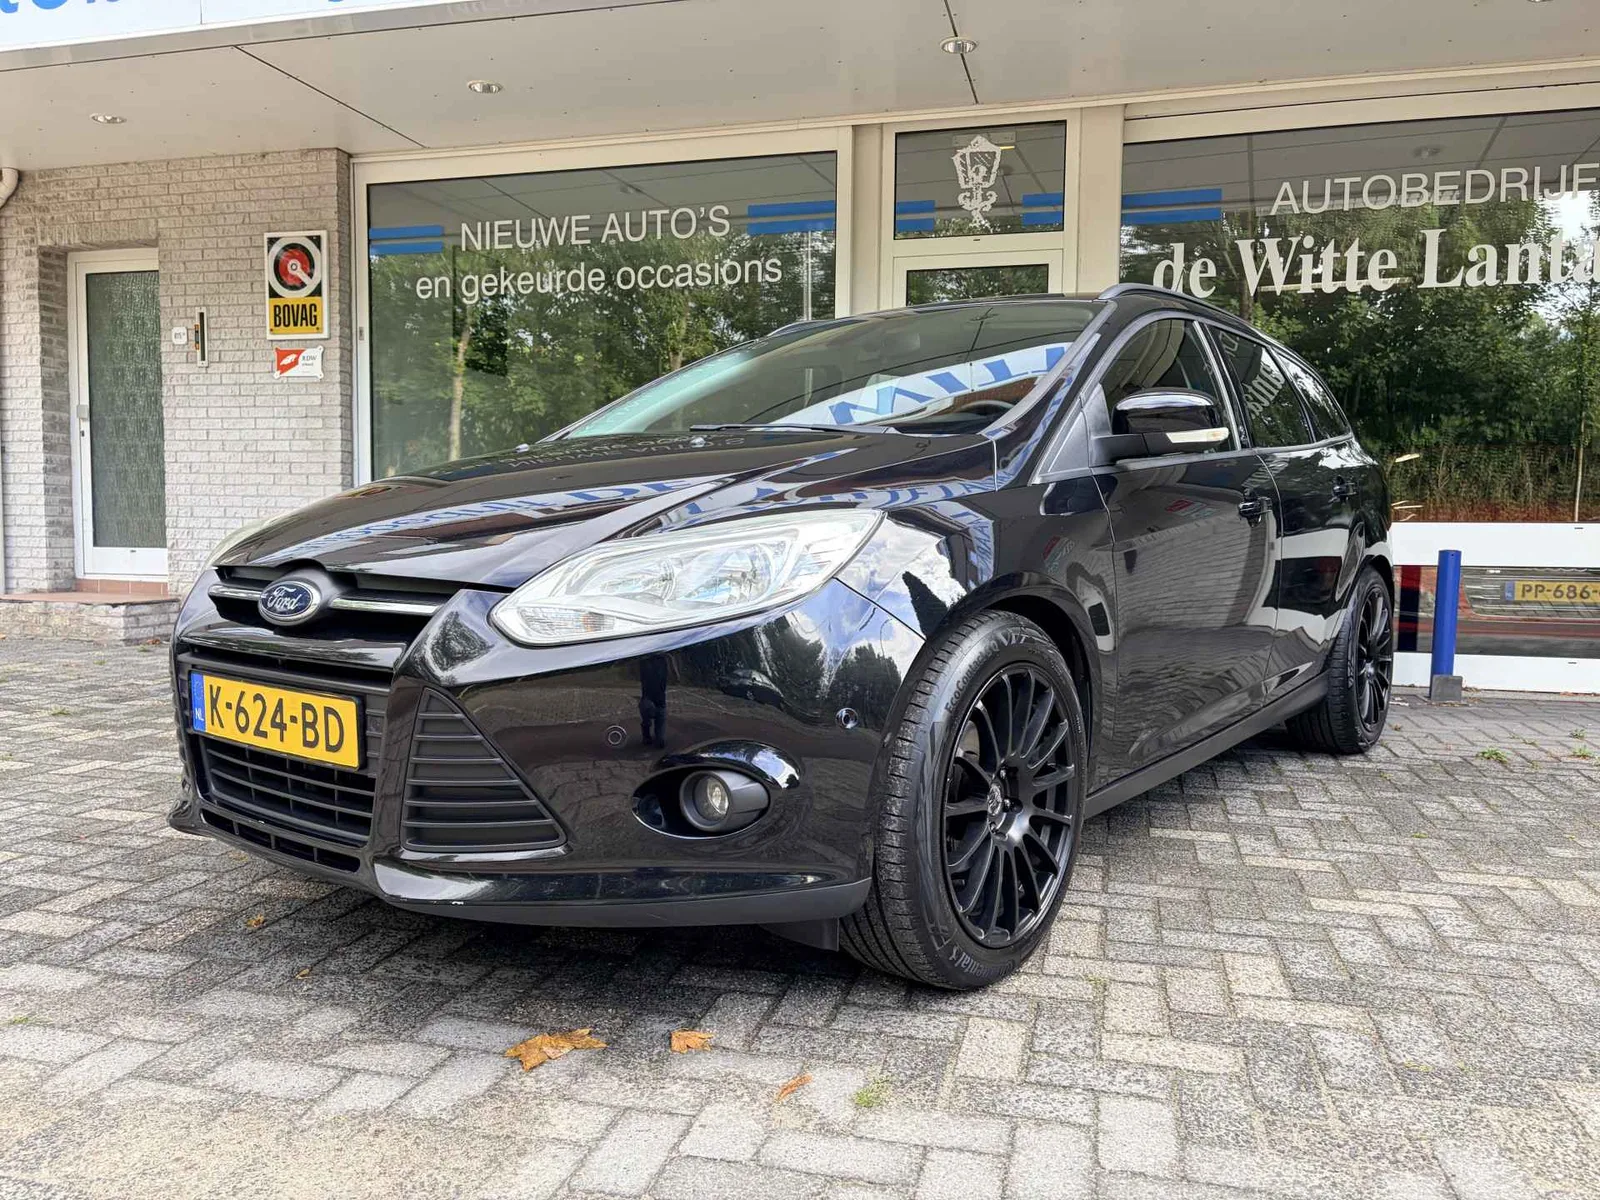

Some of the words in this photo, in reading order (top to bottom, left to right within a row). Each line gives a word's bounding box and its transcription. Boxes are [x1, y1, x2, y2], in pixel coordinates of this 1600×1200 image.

[1270, 163, 1600, 216] AUTOBEDRIJF
[461, 214, 591, 251] NIEUWE
[600, 205, 731, 243] AUTO'S
[415, 274, 451, 299] en
[461, 262, 605, 305] gekeurde
[616, 253, 782, 291] occasions
[1153, 242, 1217, 298] de
[1234, 234, 1398, 297] Witte
[273, 303, 318, 328] BOVAG
[267, 586, 301, 611] Ford
[1521, 584, 1600, 600] PP-686-
[195, 707, 204, 721] NL
[208, 684, 345, 753] K-624-BD
